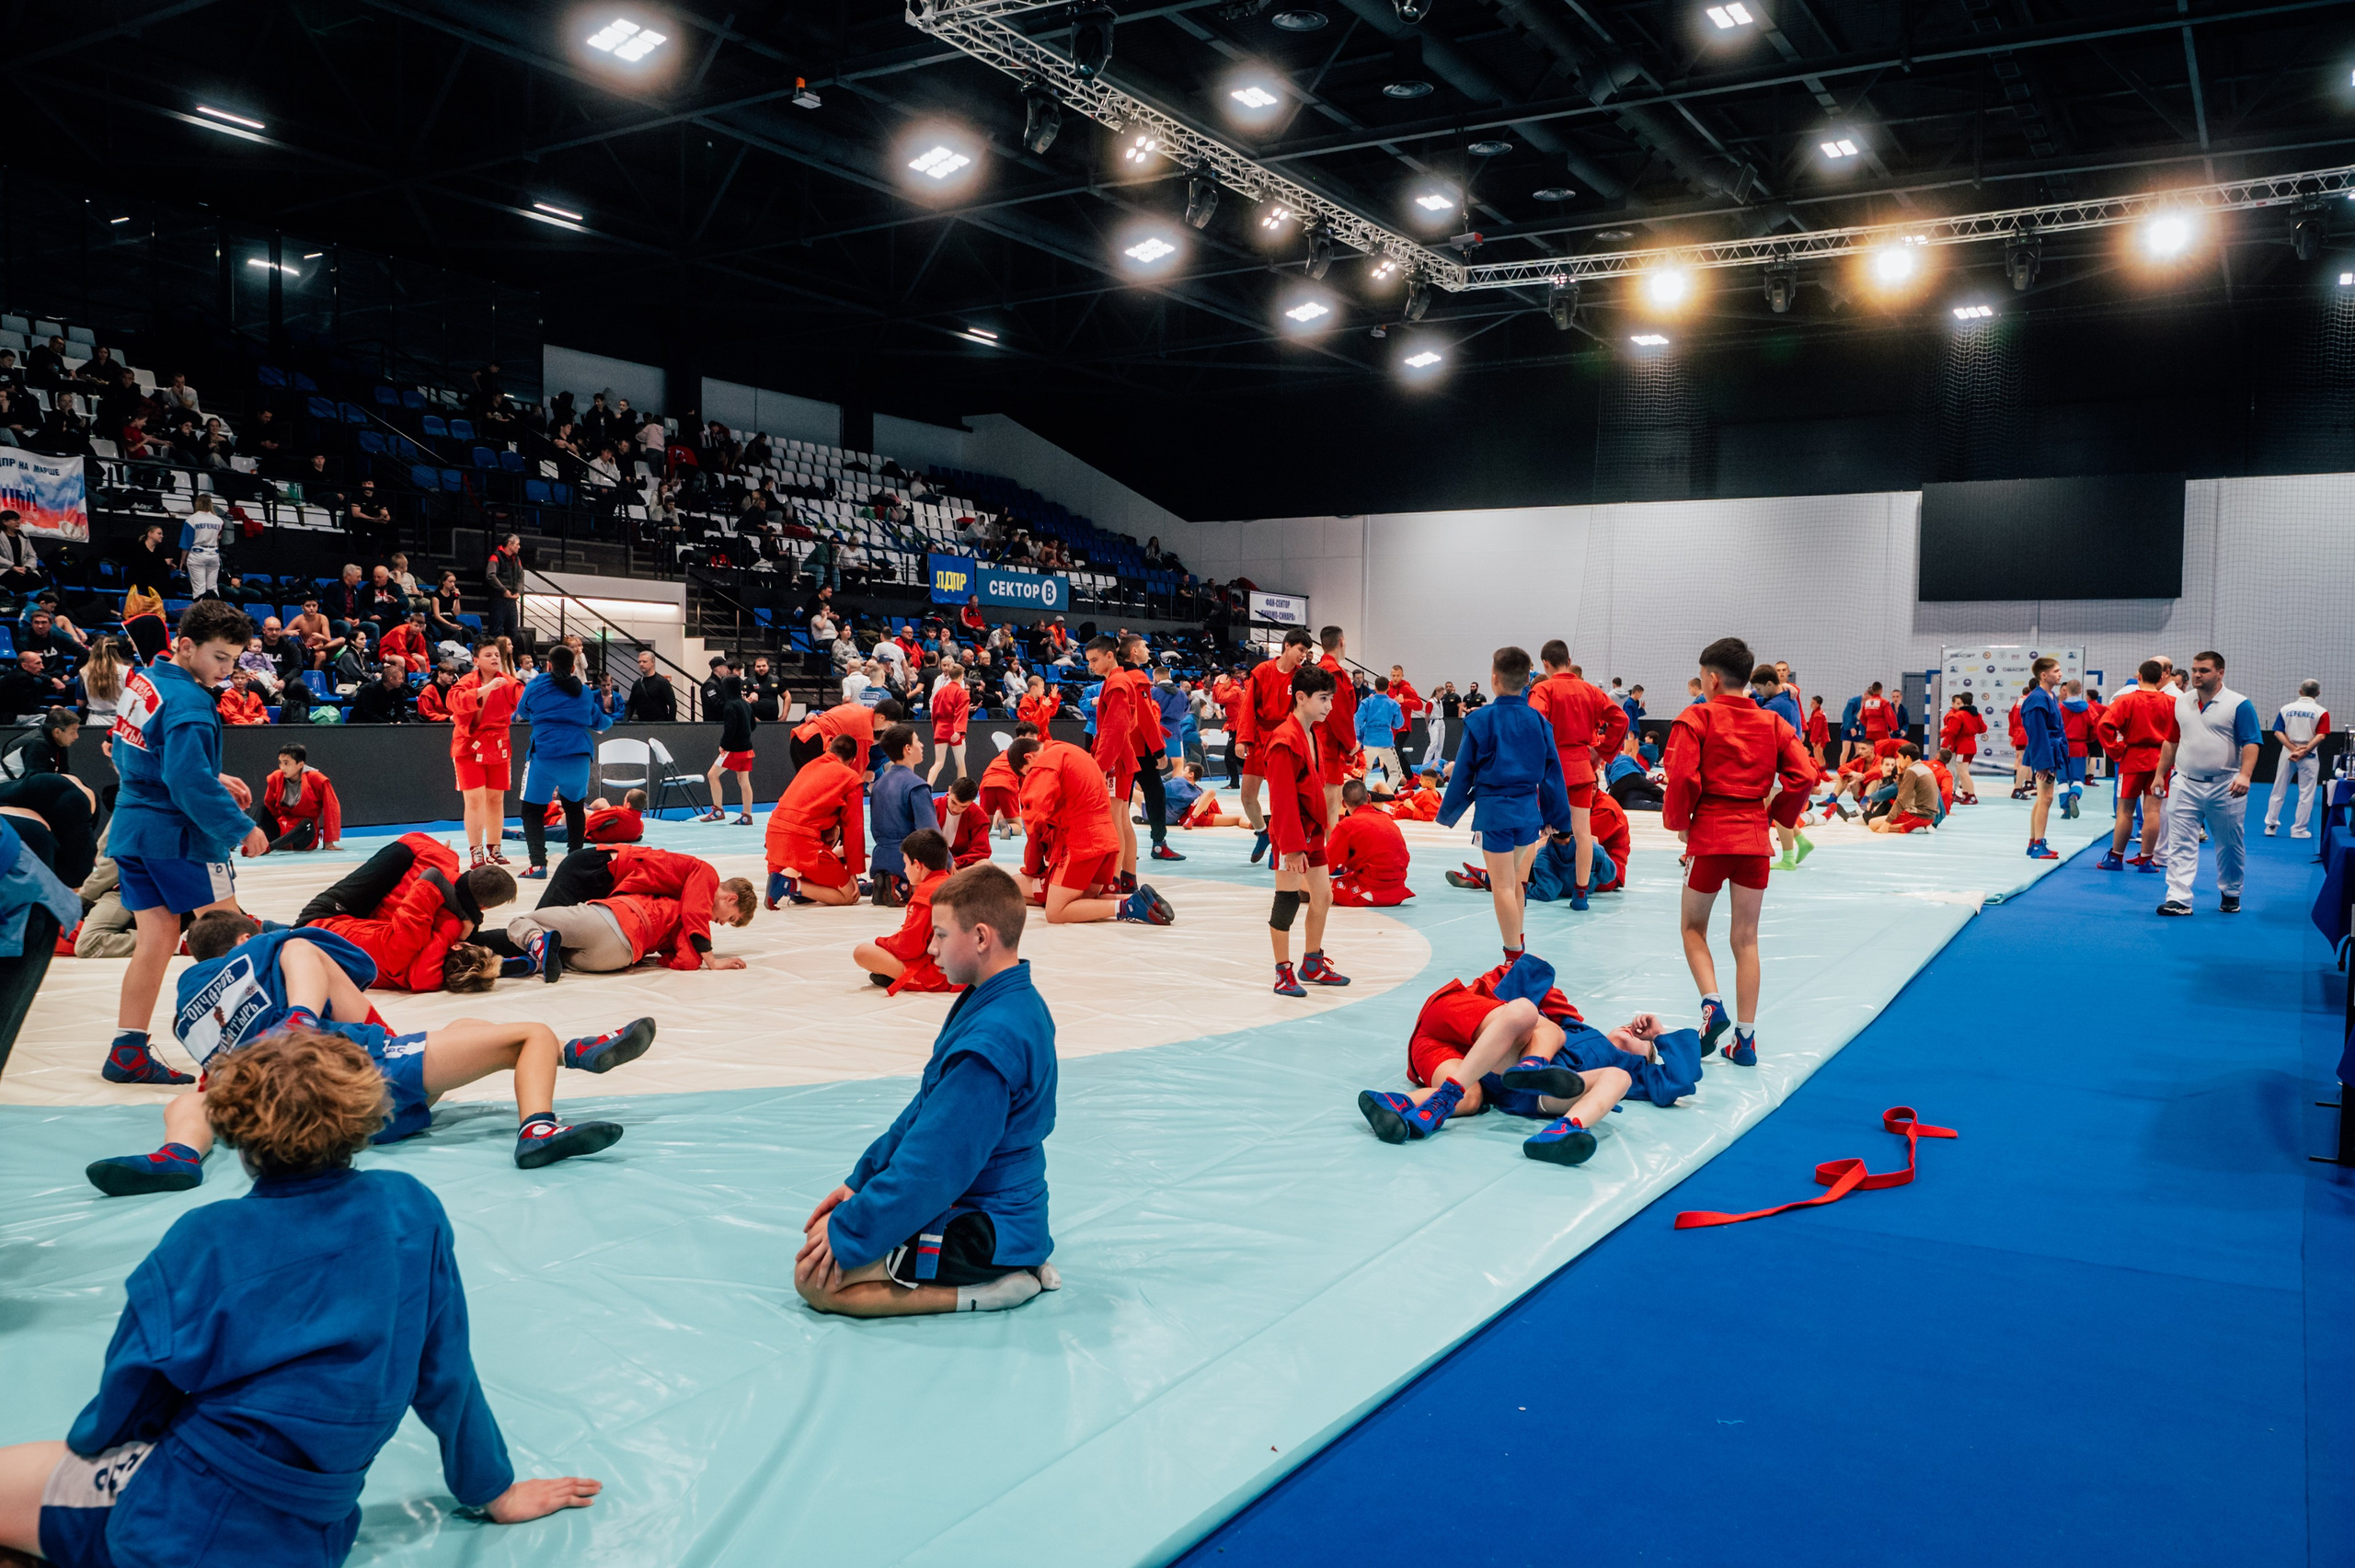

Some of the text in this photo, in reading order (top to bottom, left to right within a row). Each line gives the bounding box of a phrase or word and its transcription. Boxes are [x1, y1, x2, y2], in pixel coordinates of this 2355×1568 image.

[18, 461, 29, 471] НА
[33, 464, 60, 476] МАРШЕ
[935, 570, 967, 593] ЛДПР
[989, 579, 1040, 599] СЕКТОР
[1265, 598, 1291, 609] ФАН-СЕКТОР
[2285, 710, 2315, 719] REFEREE
[184, 968, 236, 1027] ОНЧАРОВ
